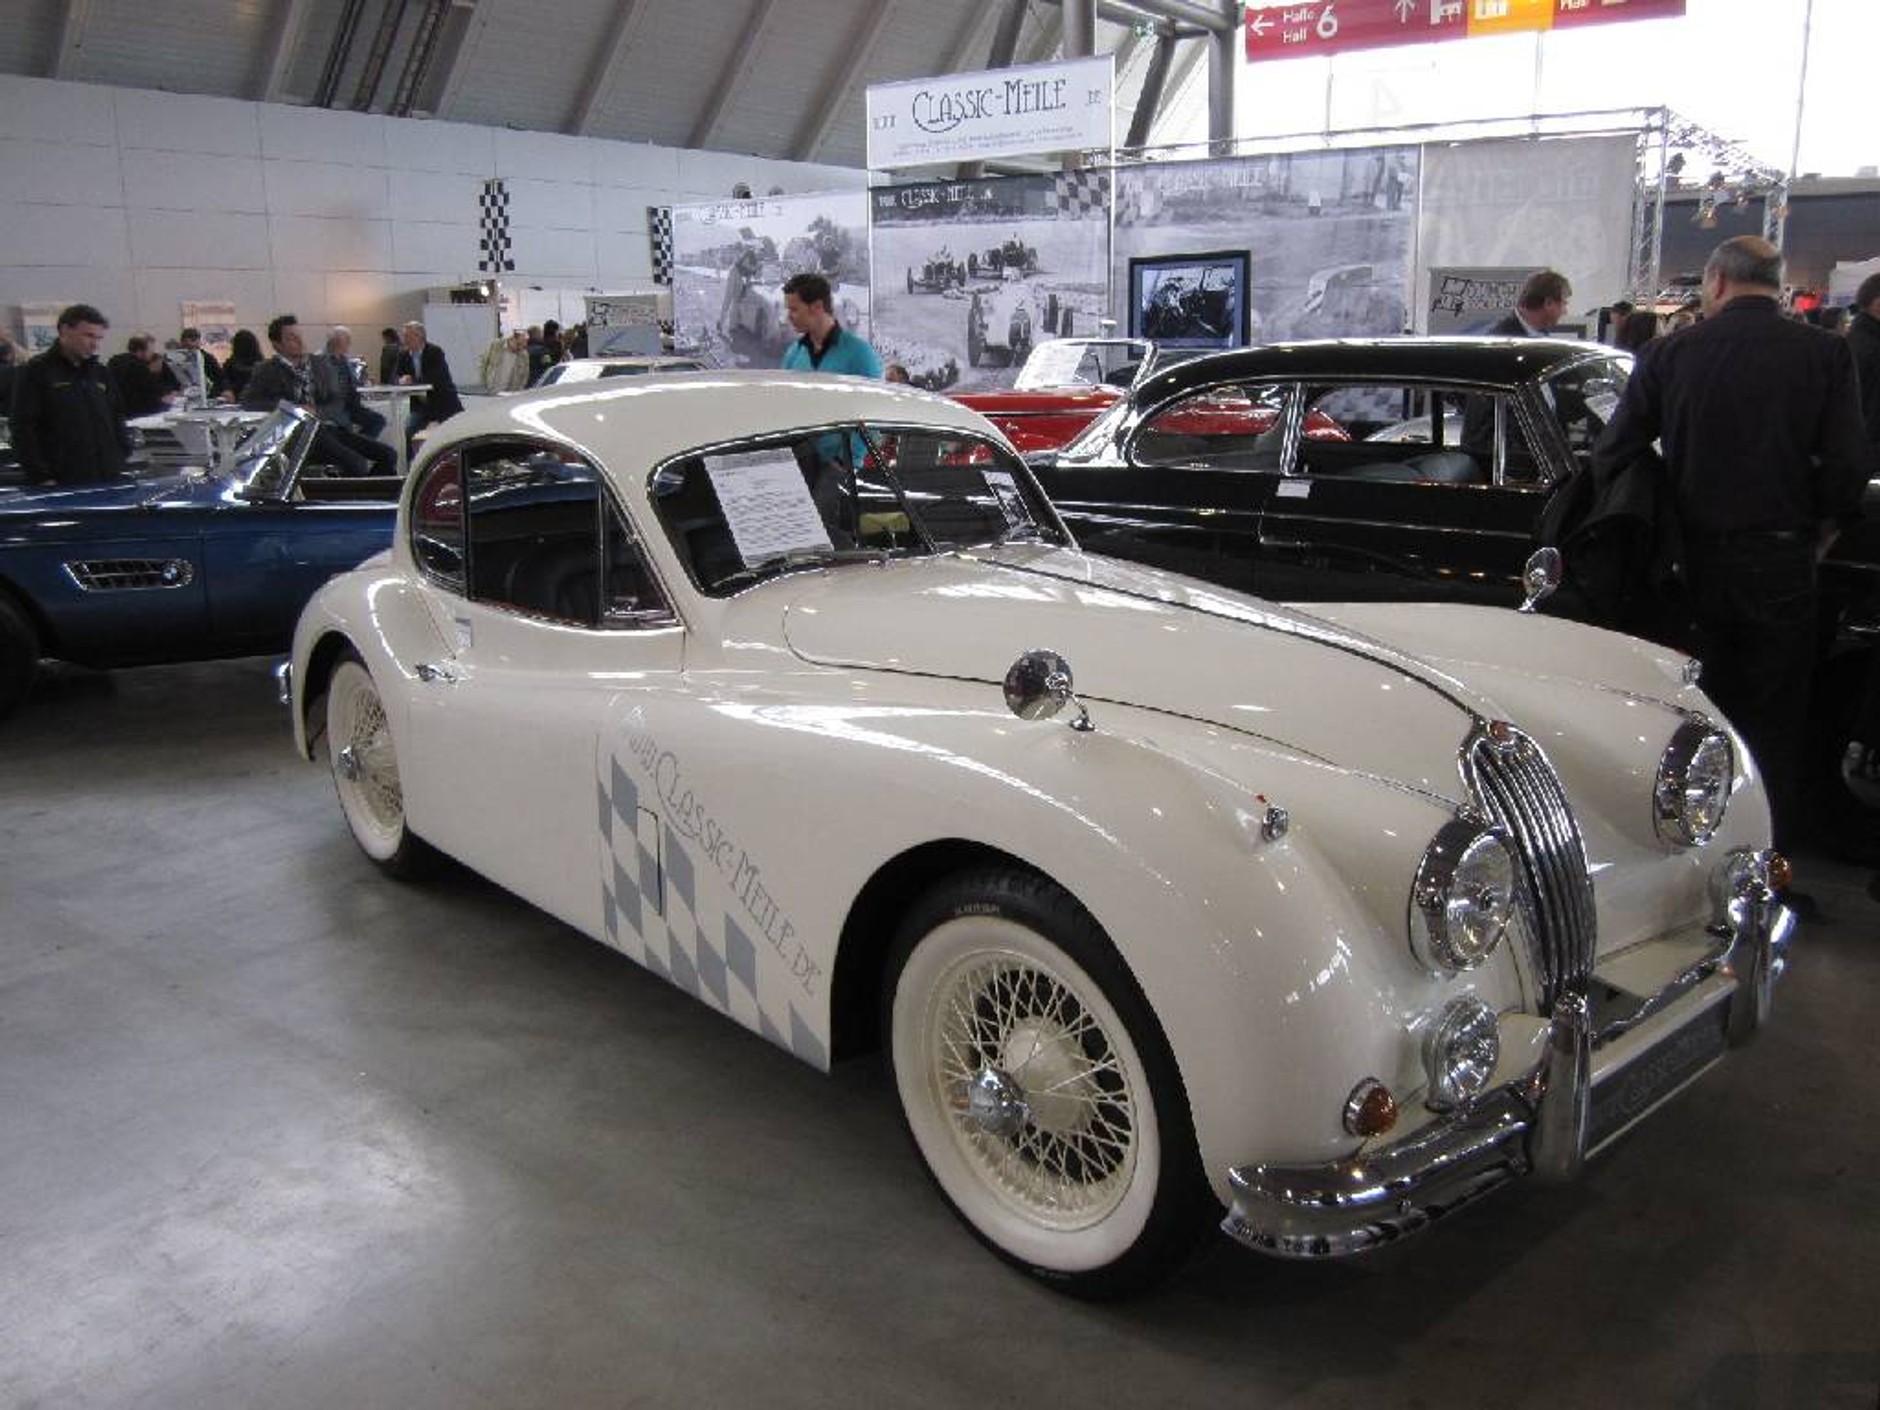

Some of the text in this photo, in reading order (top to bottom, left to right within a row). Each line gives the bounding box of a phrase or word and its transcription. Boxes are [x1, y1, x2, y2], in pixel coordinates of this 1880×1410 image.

[1283, 28, 1307, 43] Hall
[1316, 4, 1338, 39] 6
[912, 79, 1066, 133] CLASSIC-MEILE
